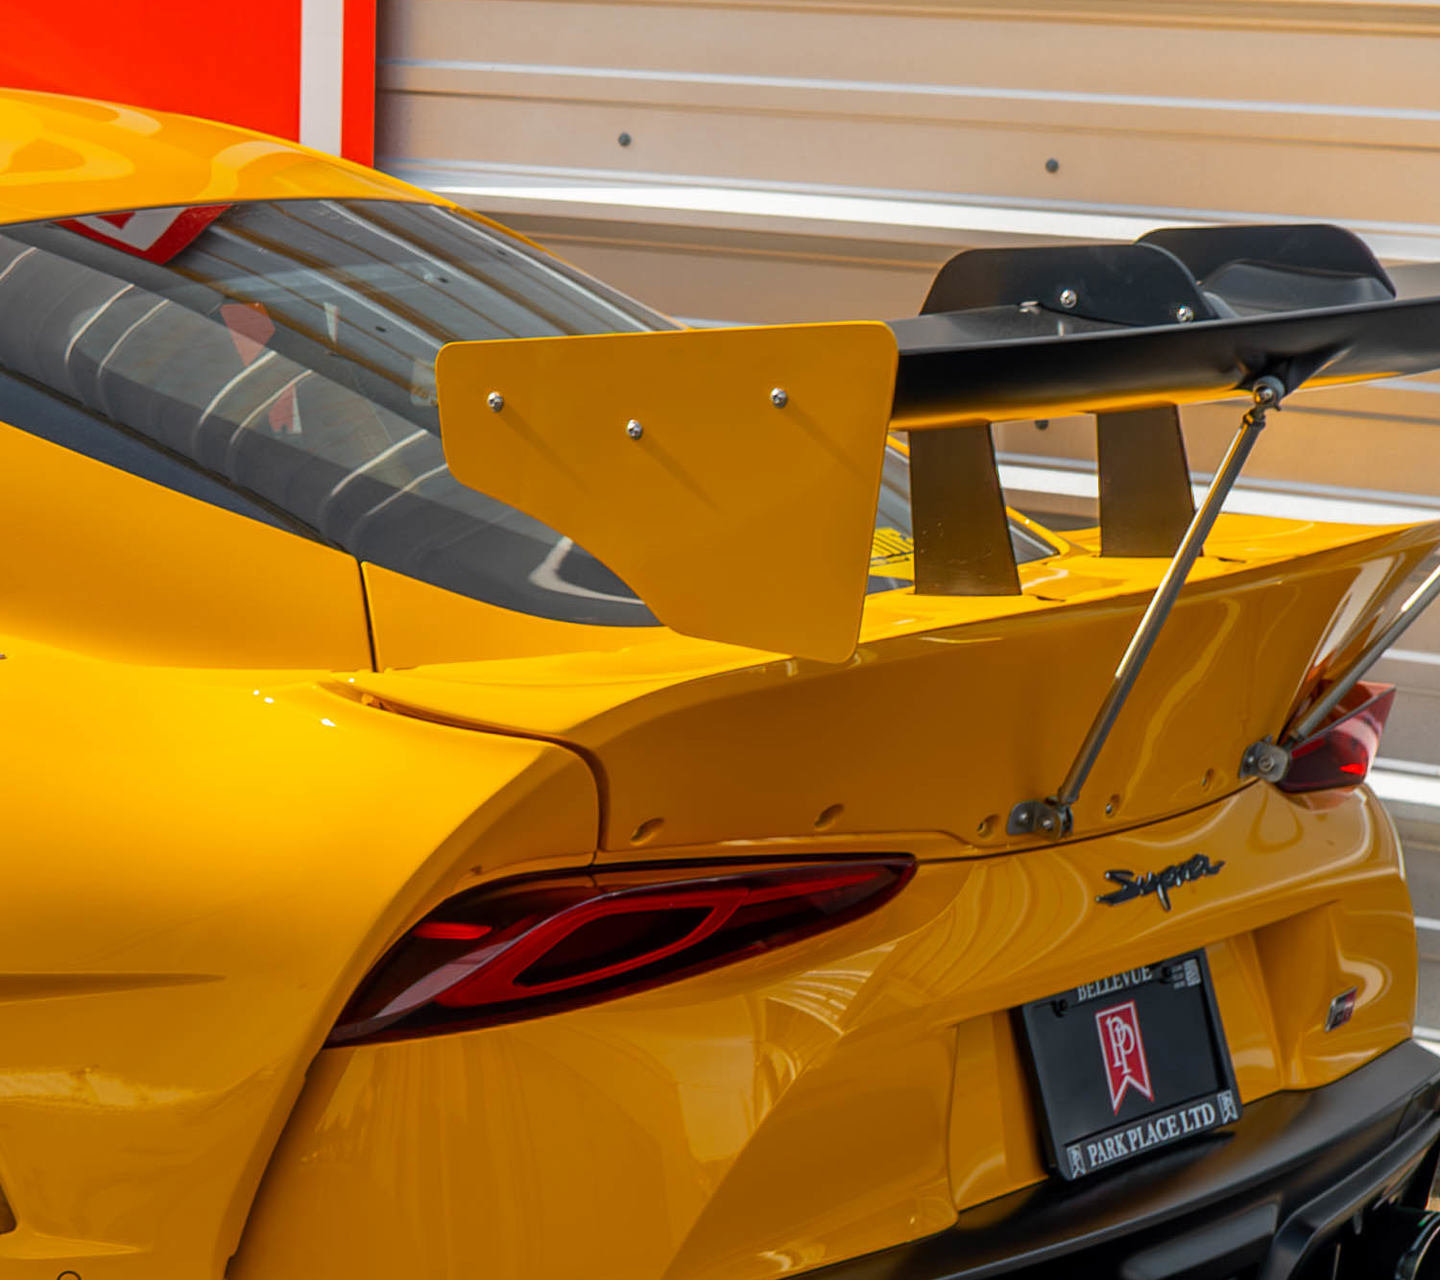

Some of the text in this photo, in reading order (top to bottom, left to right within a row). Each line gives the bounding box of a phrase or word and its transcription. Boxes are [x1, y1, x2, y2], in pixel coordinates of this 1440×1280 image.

[1095, 853, 1225, 912] Supra
[1077, 967, 1153, 1002] BELLEVUE
[1086, 1133, 1130, 1167] PARK
[1126, 1113, 1181, 1153] PLACE
[1178, 1103, 1216, 1134] LTD
